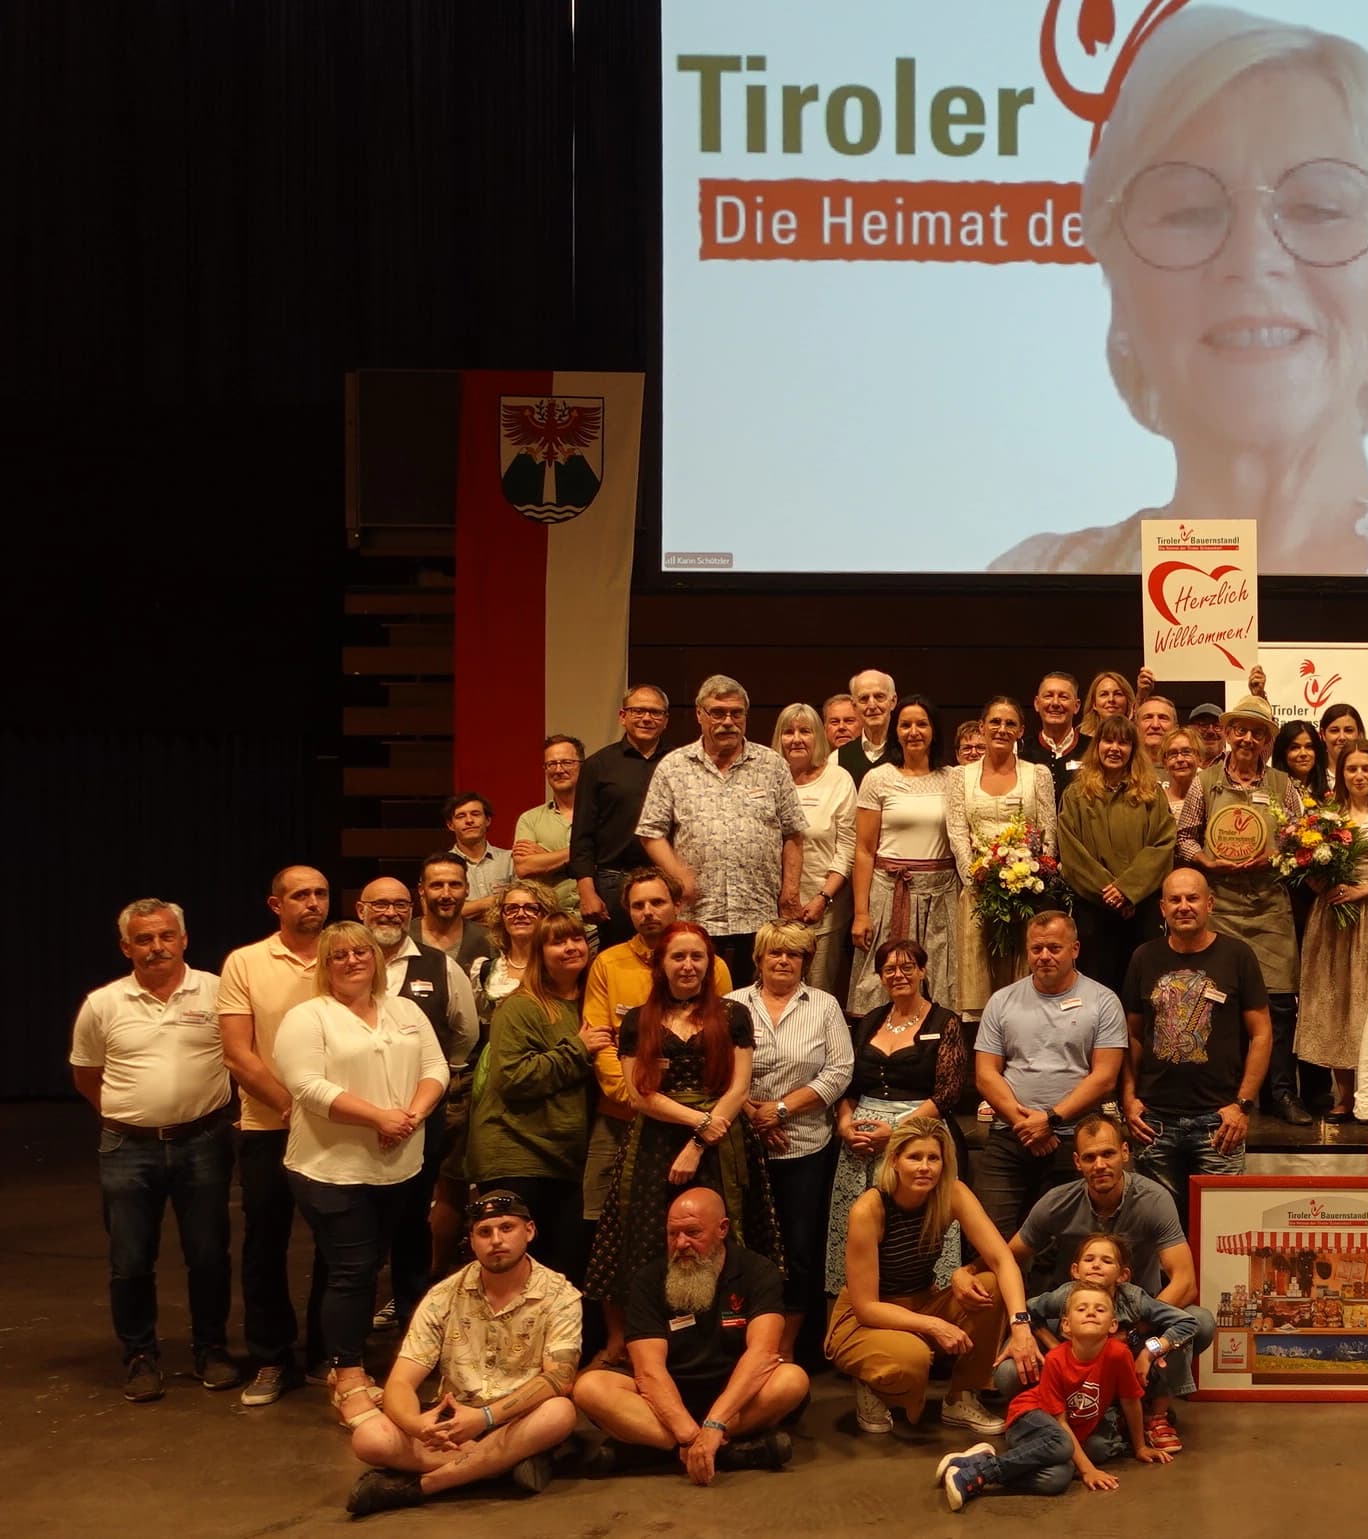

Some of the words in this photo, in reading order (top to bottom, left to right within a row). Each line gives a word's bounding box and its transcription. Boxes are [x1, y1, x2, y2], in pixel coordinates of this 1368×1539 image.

[677, 54, 1035, 157] Tiroler
[715, 196, 797, 246] Die
[823, 197, 1008, 248] Heimat
[1157, 536, 1181, 545] Tiroler
[1190, 536, 1240, 545] Bauernstandl
[1174, 579, 1249, 613] Herzlich
[1154, 615, 1254, 654] Willkommen!
[1271, 704, 1309, 716] Tiroler
[1288, 1211, 1311, 1219] Tiroler
[1320, 1211, 1368, 1219] Bauernstandl
